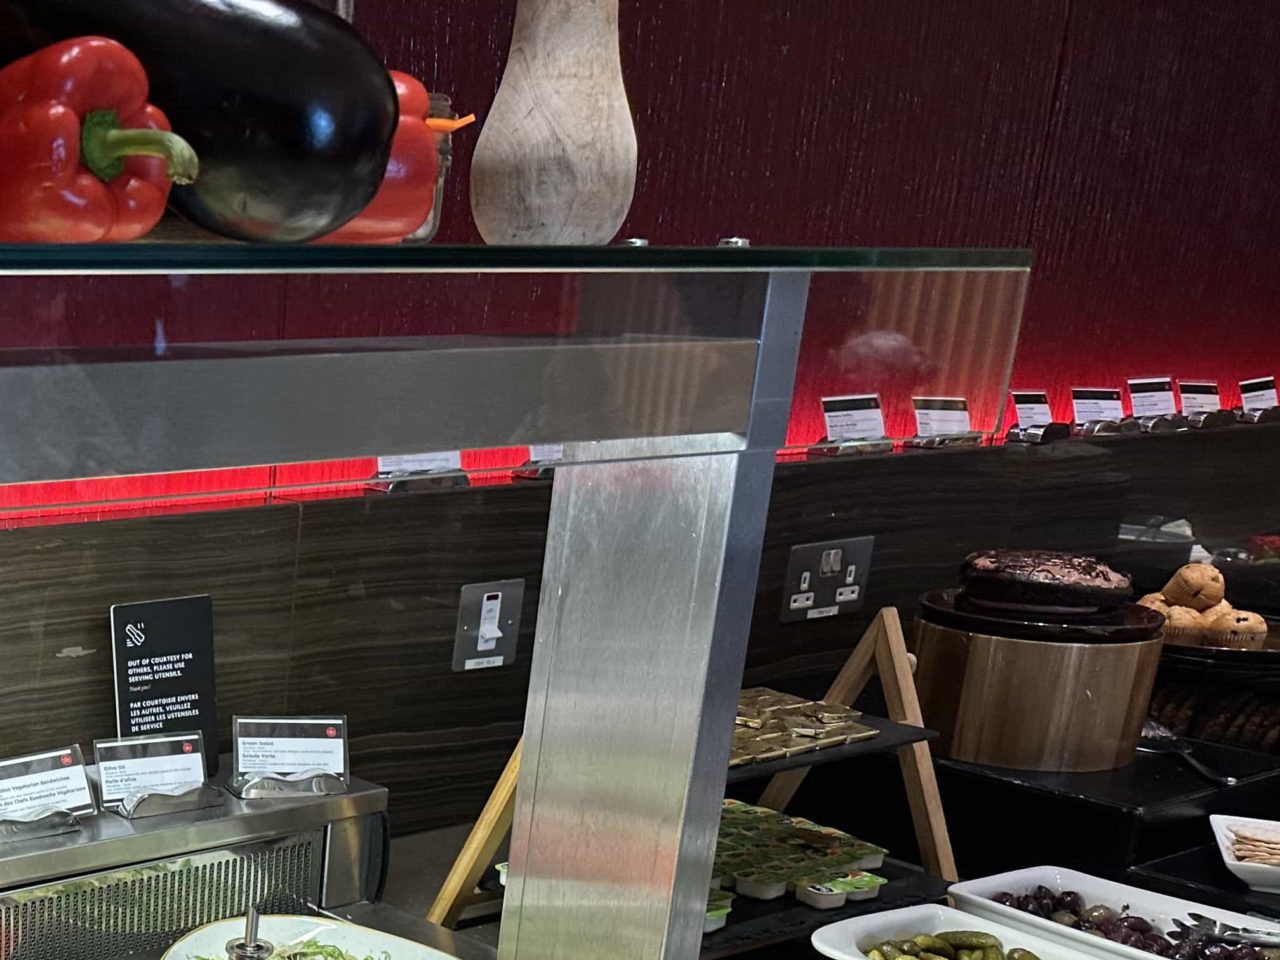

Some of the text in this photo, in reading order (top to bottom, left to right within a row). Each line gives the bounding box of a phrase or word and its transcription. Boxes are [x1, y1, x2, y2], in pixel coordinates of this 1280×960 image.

[151, 654, 180, 664] COURTESY
[129, 670, 182, 683] SERVING UTENSILS.
[142, 697, 176, 708] COURTOISIE
[178, 694, 198, 702] ENVERS
[166, 702, 190, 712] VEUILLEZ
[131, 716, 155, 724] UTILISER
[167, 709, 199, 719] USTENSILES
[141, 722, 163, 730] SERVICE
